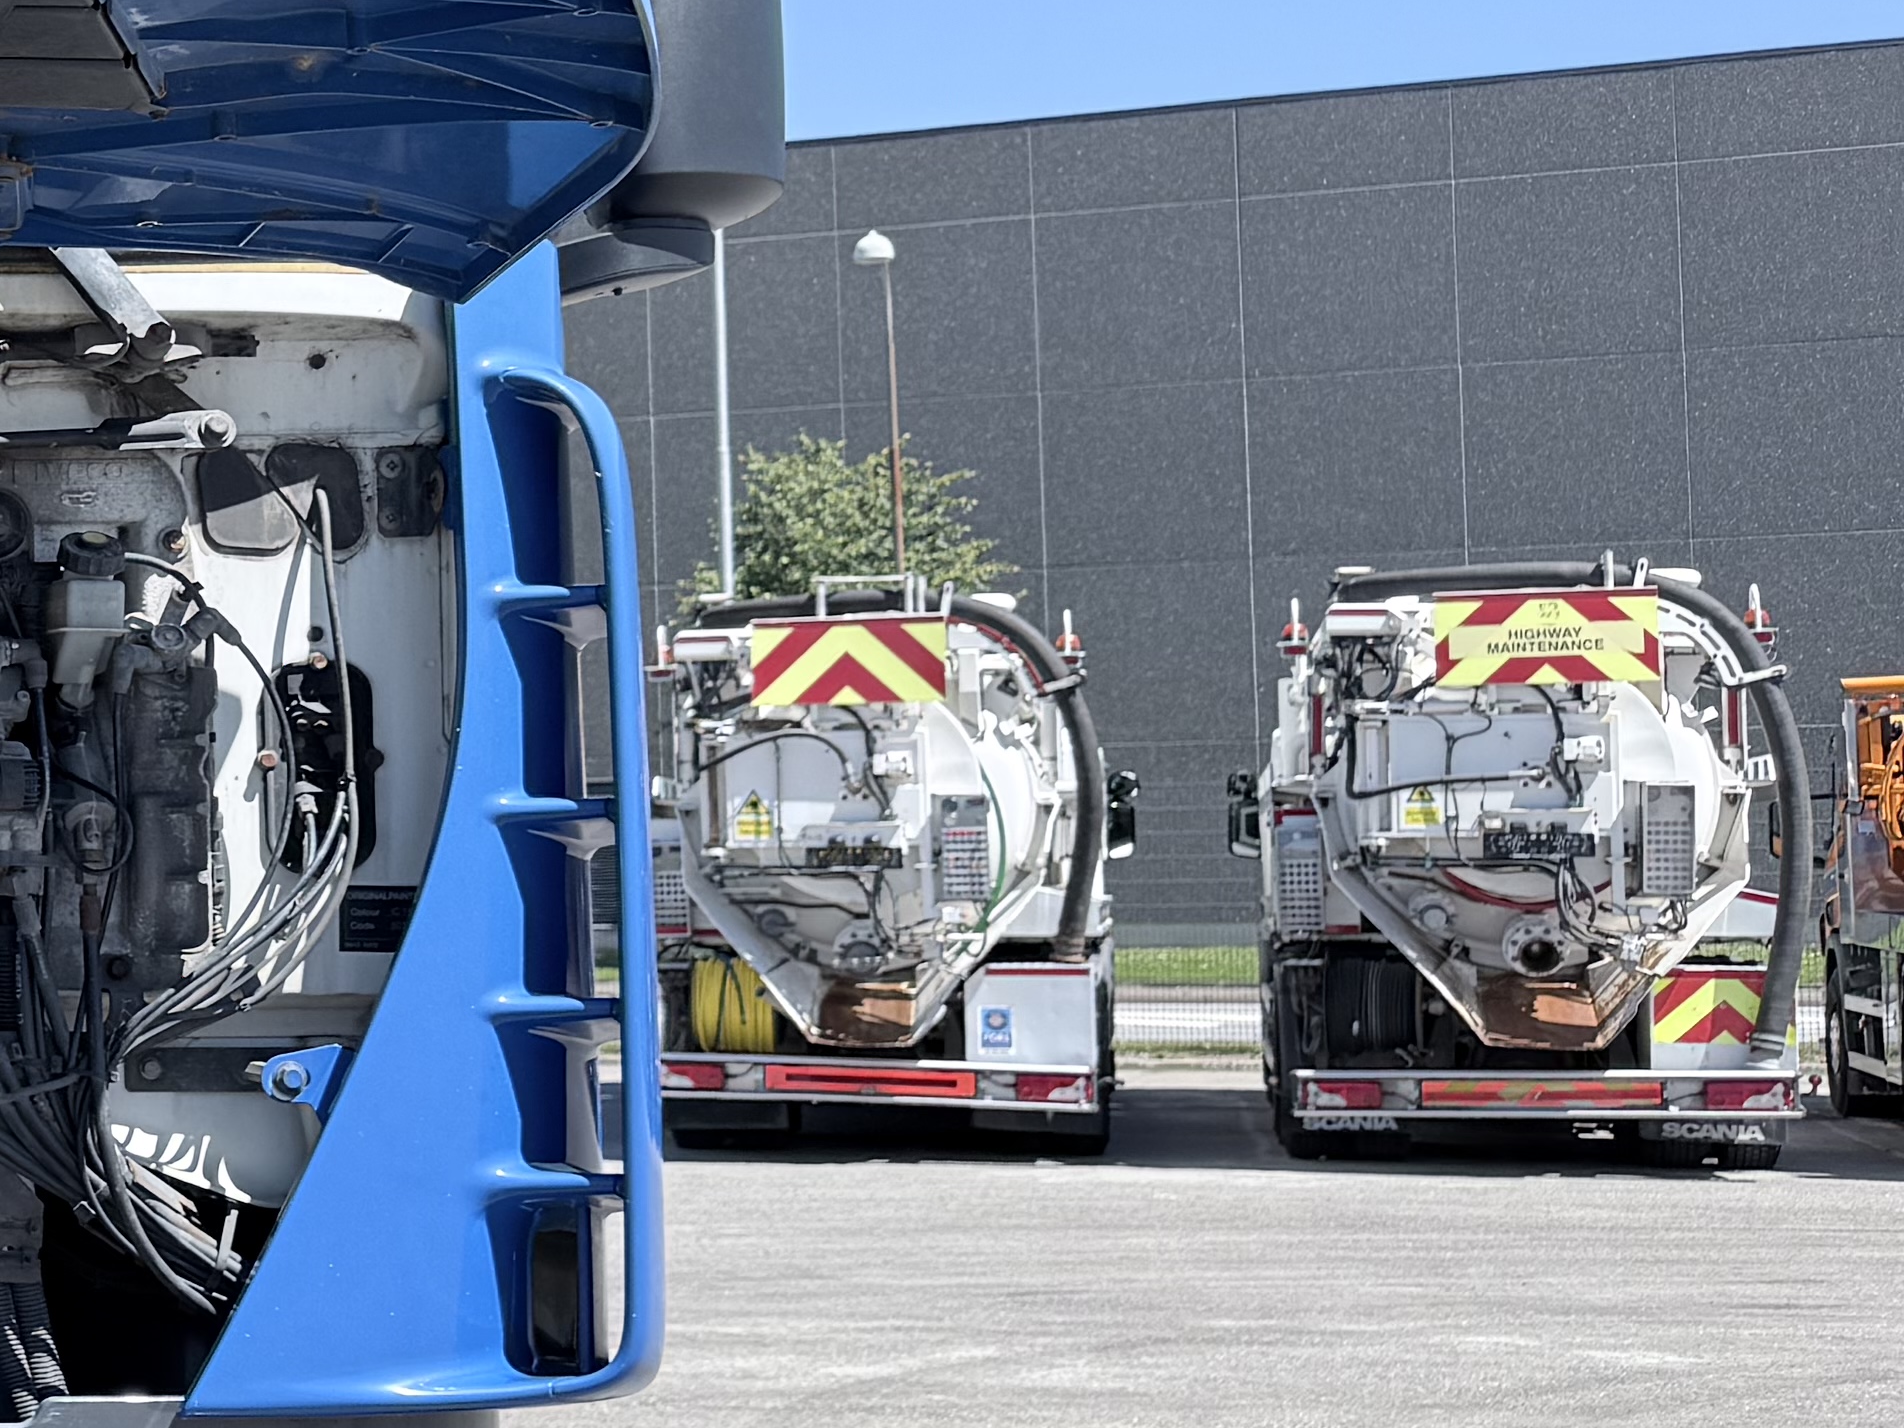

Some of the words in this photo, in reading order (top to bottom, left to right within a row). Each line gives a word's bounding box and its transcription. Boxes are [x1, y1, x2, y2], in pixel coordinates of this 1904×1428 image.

[1508, 626, 1582, 640] HIGHWAY
[1487, 638, 1604, 654] MAINTENANCE
[1302, 1116, 1398, 1130] SCANIA
[1662, 1122, 1766, 1141] SCANIA
